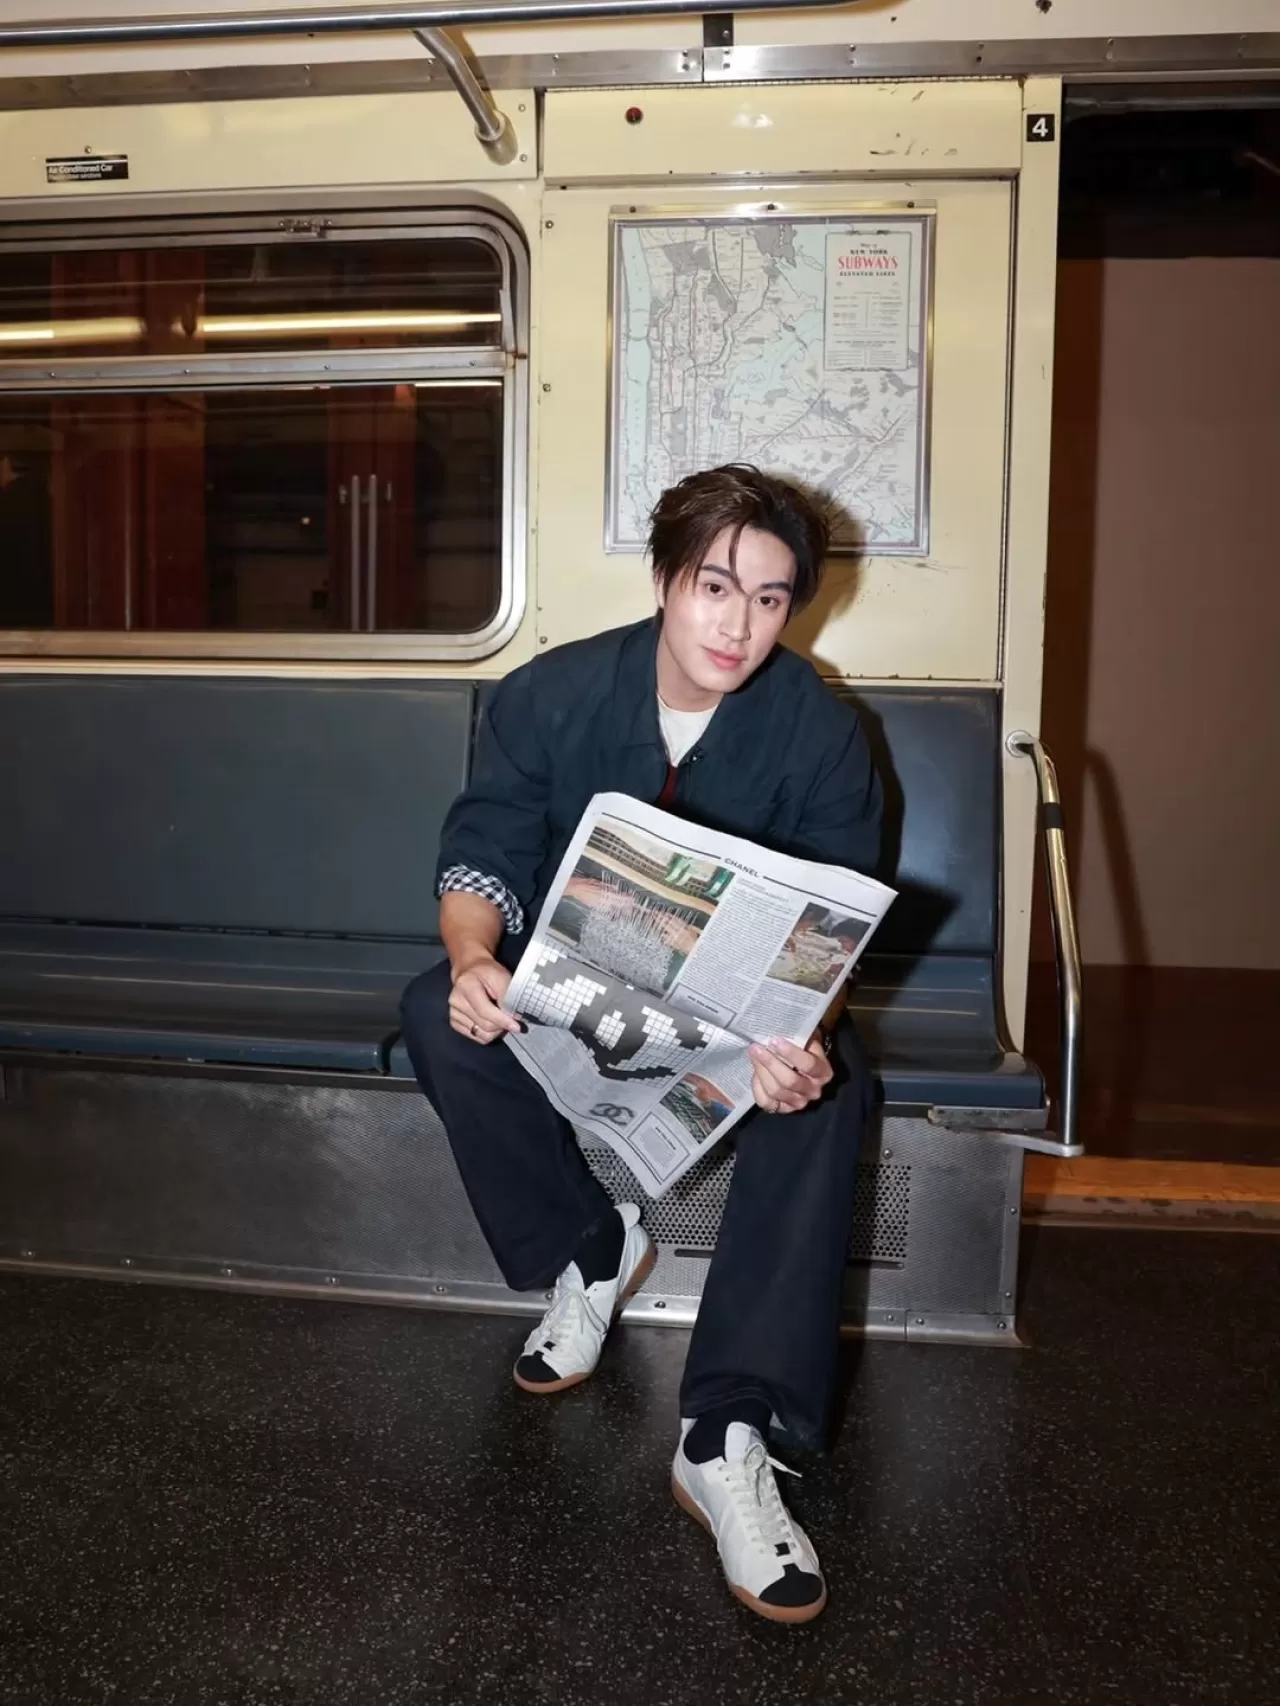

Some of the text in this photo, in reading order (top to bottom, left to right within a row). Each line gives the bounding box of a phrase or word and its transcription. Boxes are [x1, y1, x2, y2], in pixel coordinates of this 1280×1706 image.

[1032, 117, 1048, 137] 4
[100, 164, 113, 172] Car
[838, 255, 898, 269] SUBWAYS
[724, 857, 760, 878] CHANEL
